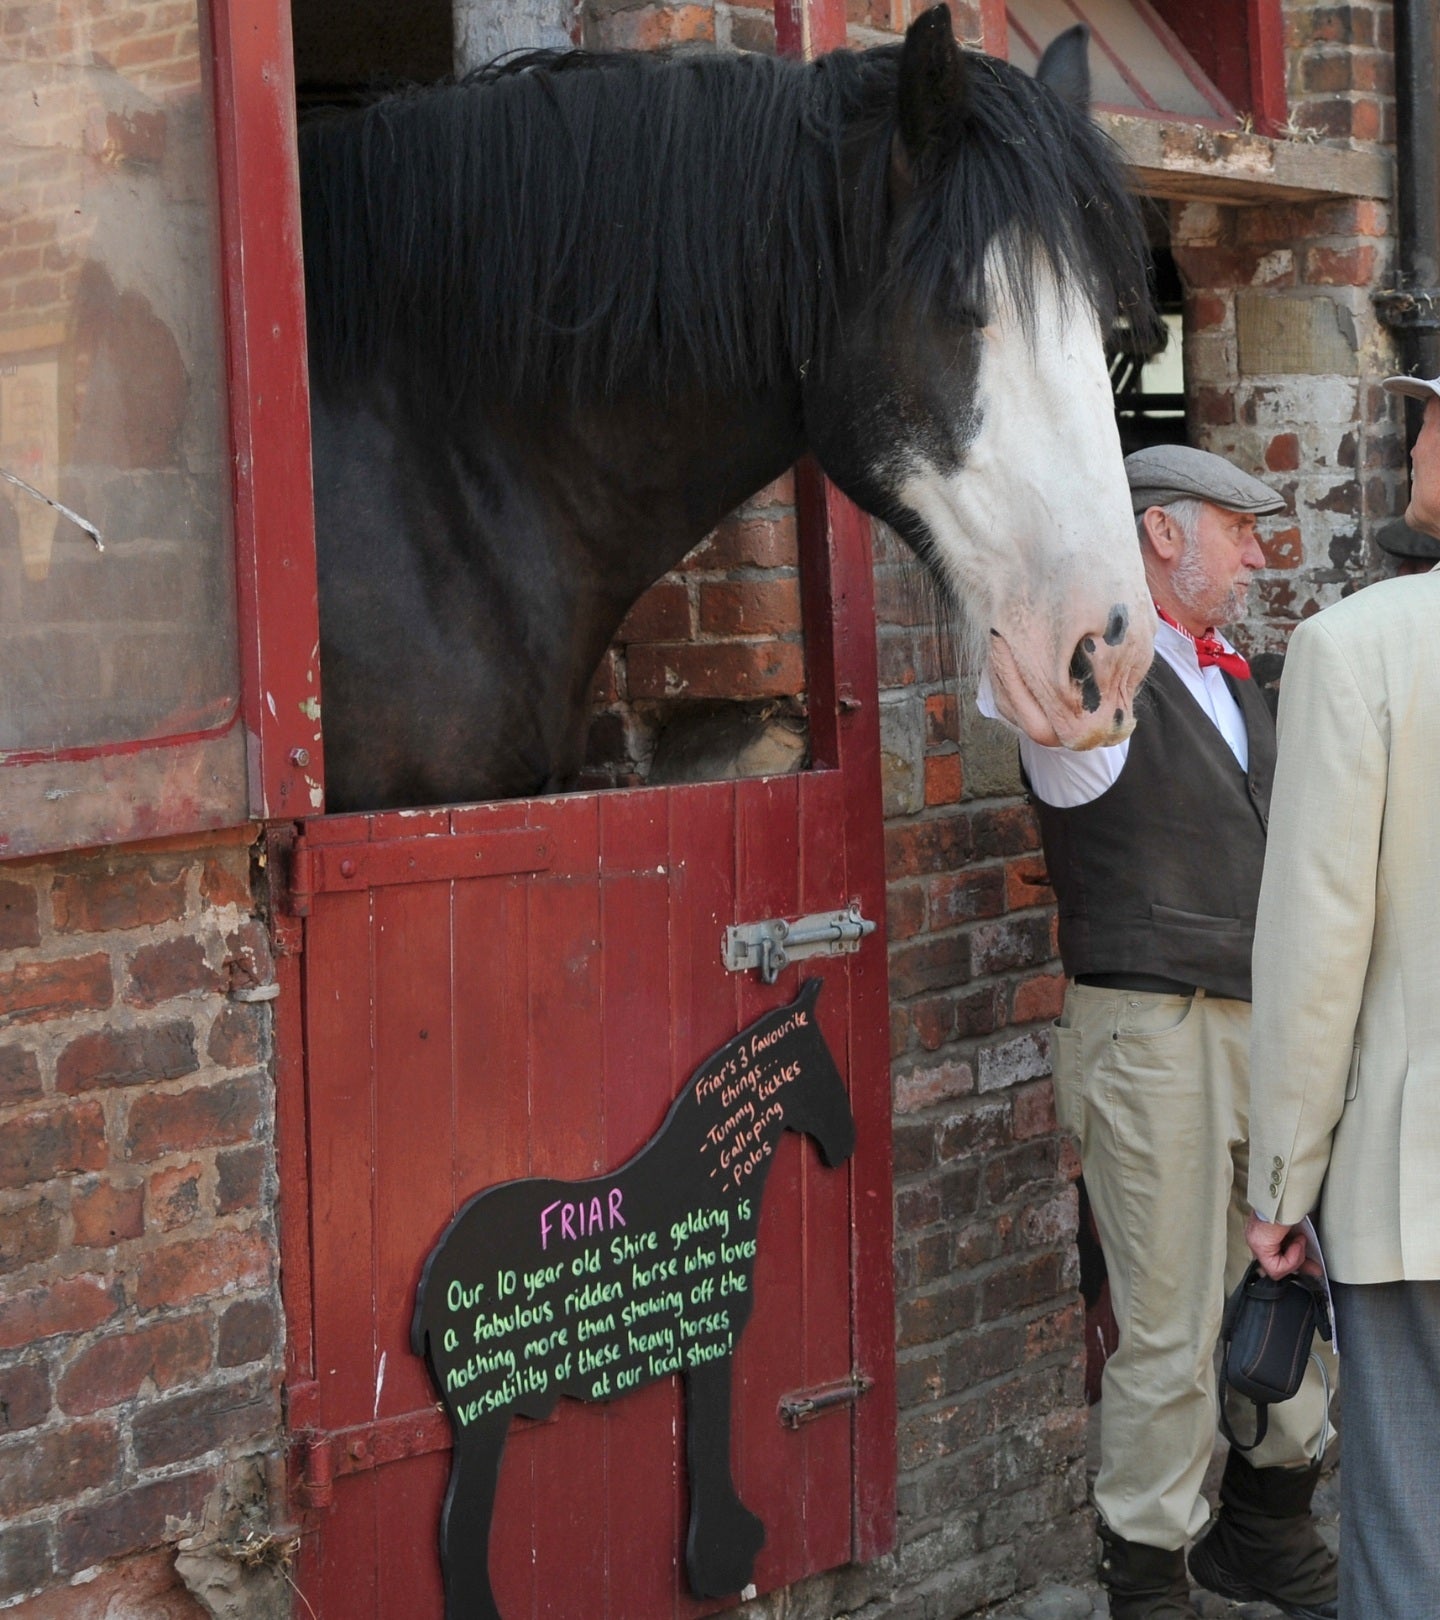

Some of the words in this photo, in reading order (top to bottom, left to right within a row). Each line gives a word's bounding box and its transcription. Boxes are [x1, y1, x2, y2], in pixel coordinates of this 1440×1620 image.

[695, 1058, 737, 1105] Friar's
[738, 1046, 748, 1067] 3
[751, 1011, 808, 1058] favourite
[758, 1060, 801, 1101] tickles
[447, 1279, 484, 1312] Our
[497, 1269, 517, 1301] 10
[524, 1261, 564, 1301] year
[571, 1248, 601, 1277] old
[611, 1231, 658, 1265] Shire
[670, 1208, 730, 1251] gelding
[737, 1197, 752, 1221] is
[541, 1188, 627, 1249] FRIAR
[443, 1328, 459, 1352] a
[473, 1300, 554, 1344] fabulous
[565, 1282, 623, 1315] ridden
[633, 1257, 678, 1290] horse
[684, 1246, 716, 1275] who
[721, 1238, 757, 1264] loves
[447, 1348, 516, 1393] nothing
[524, 1327, 568, 1360] more
[577, 1315, 616, 1343] than
[621, 1290, 683, 1327] showing
[690, 1278, 715, 1305] off
[720, 1270, 748, 1297] the
[457, 1367, 548, 1427] versatility
[555, 1352, 572, 1381] of
[578, 1343, 621, 1375] these
[628, 1326, 674, 1355] heavy
[680, 1309, 730, 1340] horses
[591, 1372, 611, 1398] at
[617, 1365, 642, 1390] our
[649, 1346, 682, 1377] local
[687, 1332, 733, 1368] show!
